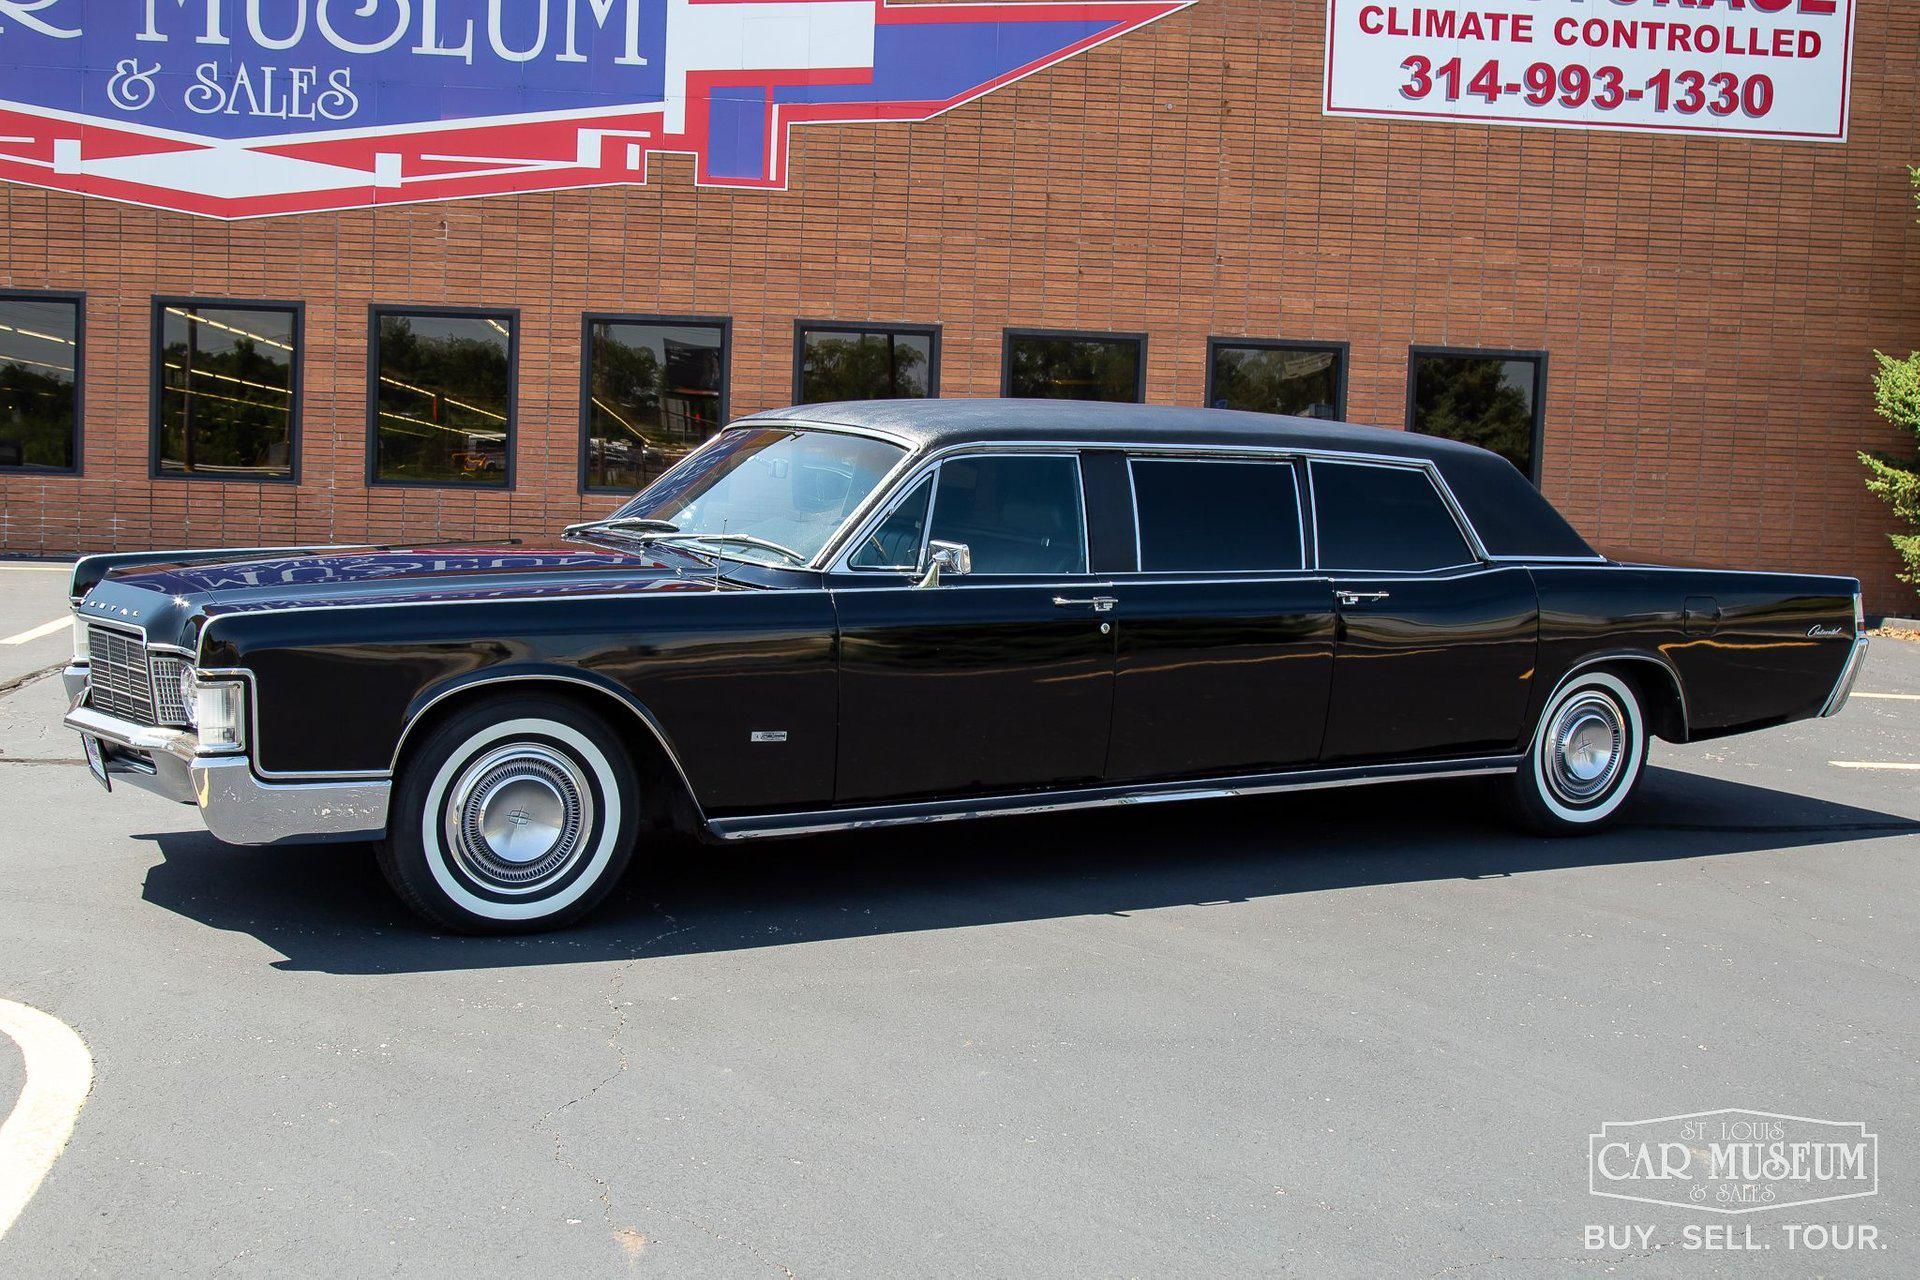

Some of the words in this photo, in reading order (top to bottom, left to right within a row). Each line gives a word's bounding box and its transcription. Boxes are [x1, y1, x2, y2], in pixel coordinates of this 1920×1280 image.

[1359, 5, 1533, 43] CLIMATE
[1554, 17, 1822, 58] CONTROLLED
[107, 58, 162, 111] &
[184, 61, 359, 120] SALES
[1399, 54, 1774, 118] 314-993-1330
